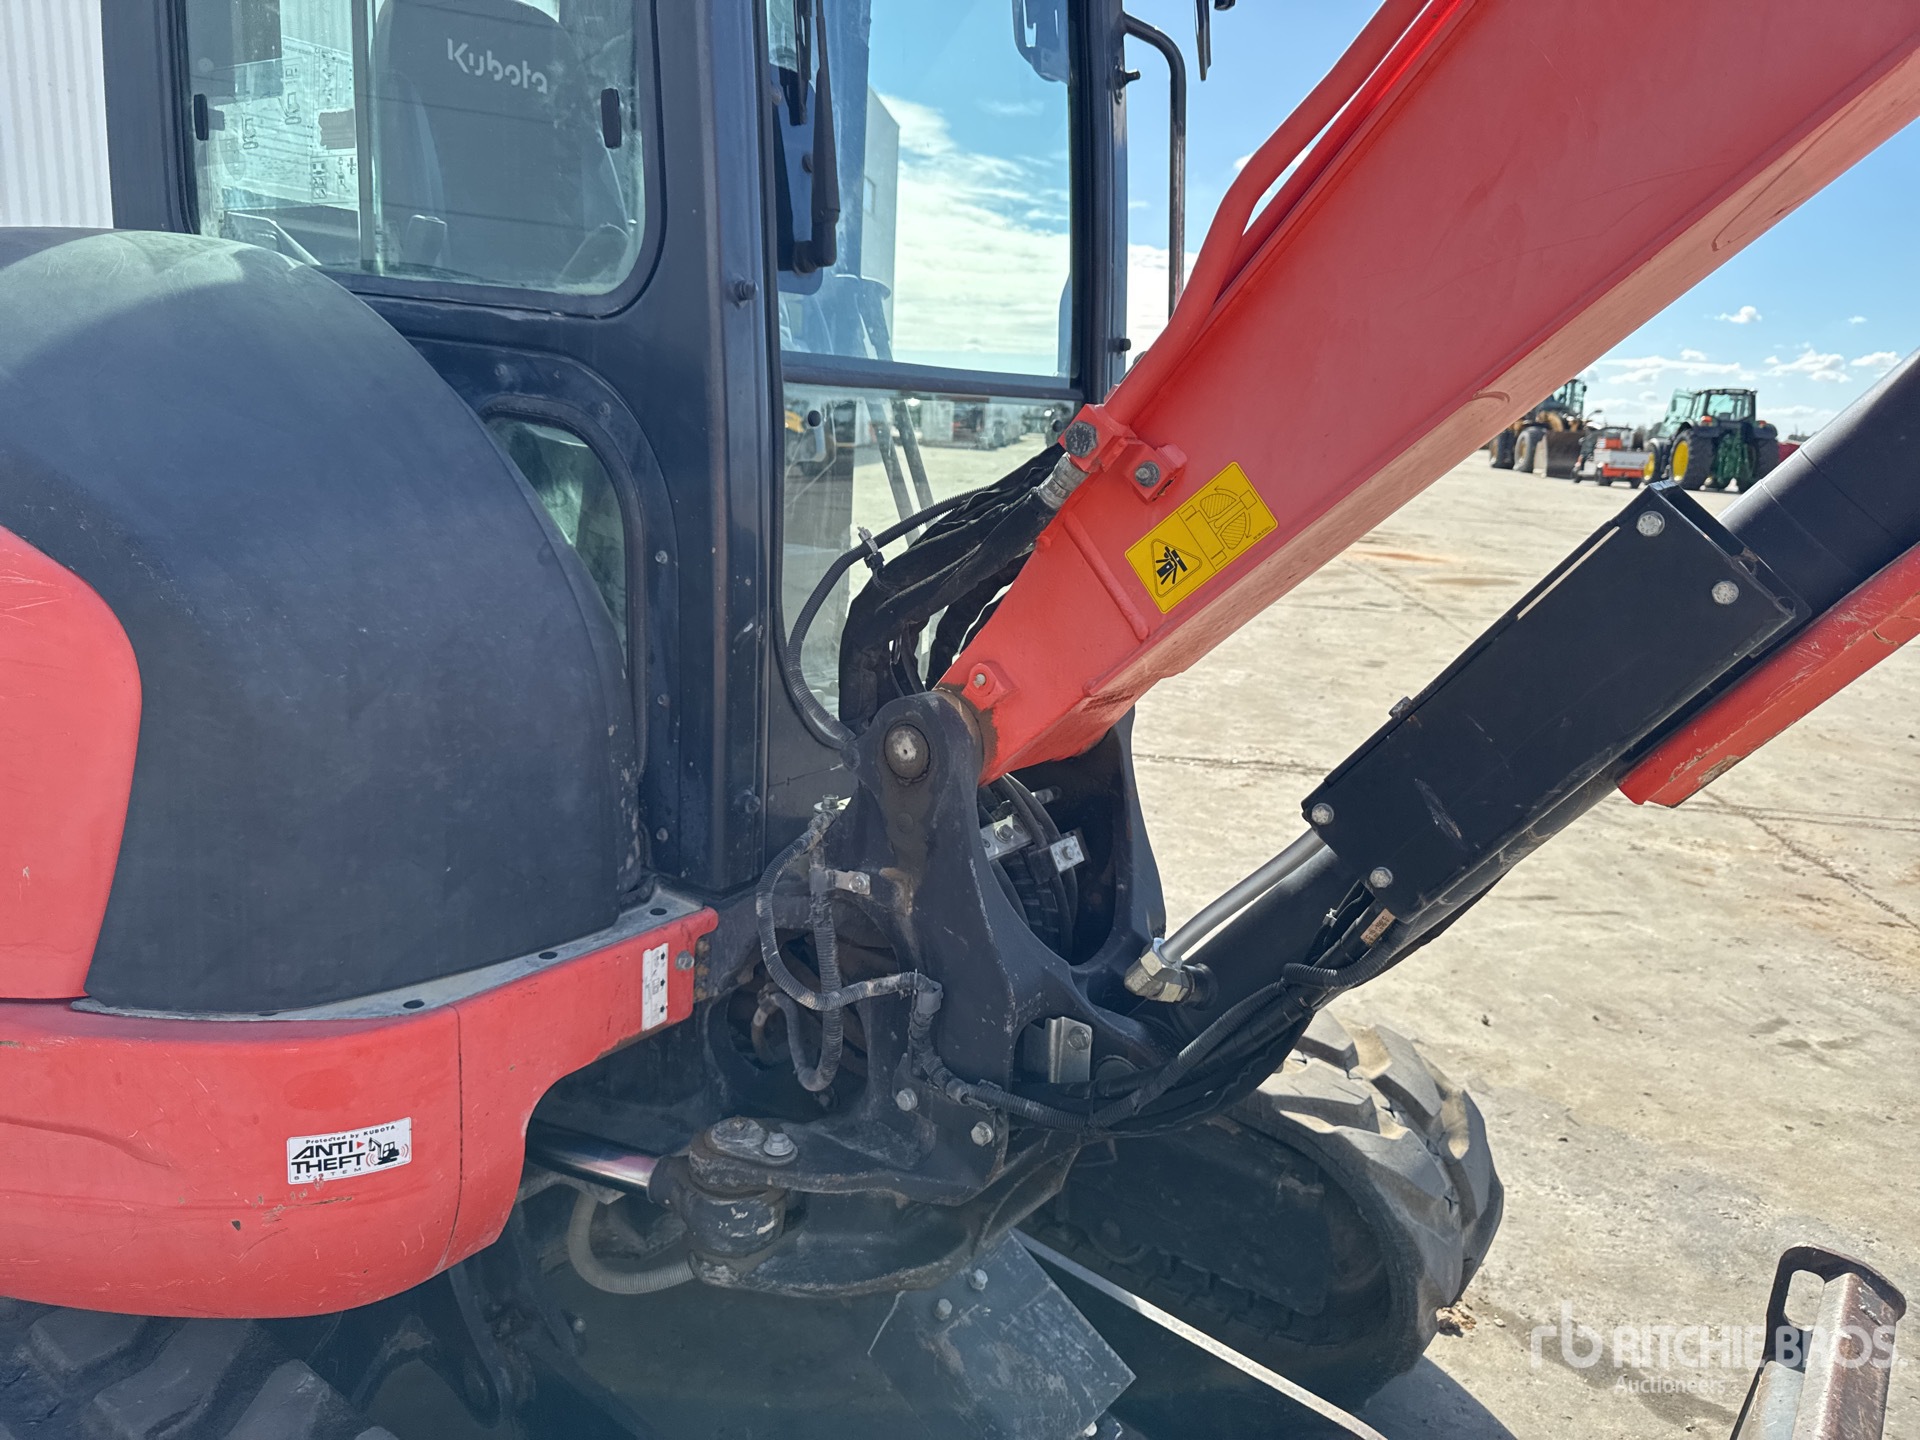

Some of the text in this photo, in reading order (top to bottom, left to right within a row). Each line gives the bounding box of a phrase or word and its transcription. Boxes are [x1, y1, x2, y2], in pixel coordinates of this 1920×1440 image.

[447, 38, 548, 94] Kubota
[305, 1135, 347, 1145] Protected
[363, 1125, 396, 1136] KUBOTA
[292, 1140, 354, 1160] ANTI
[291, 1152, 366, 1174] THEFT
